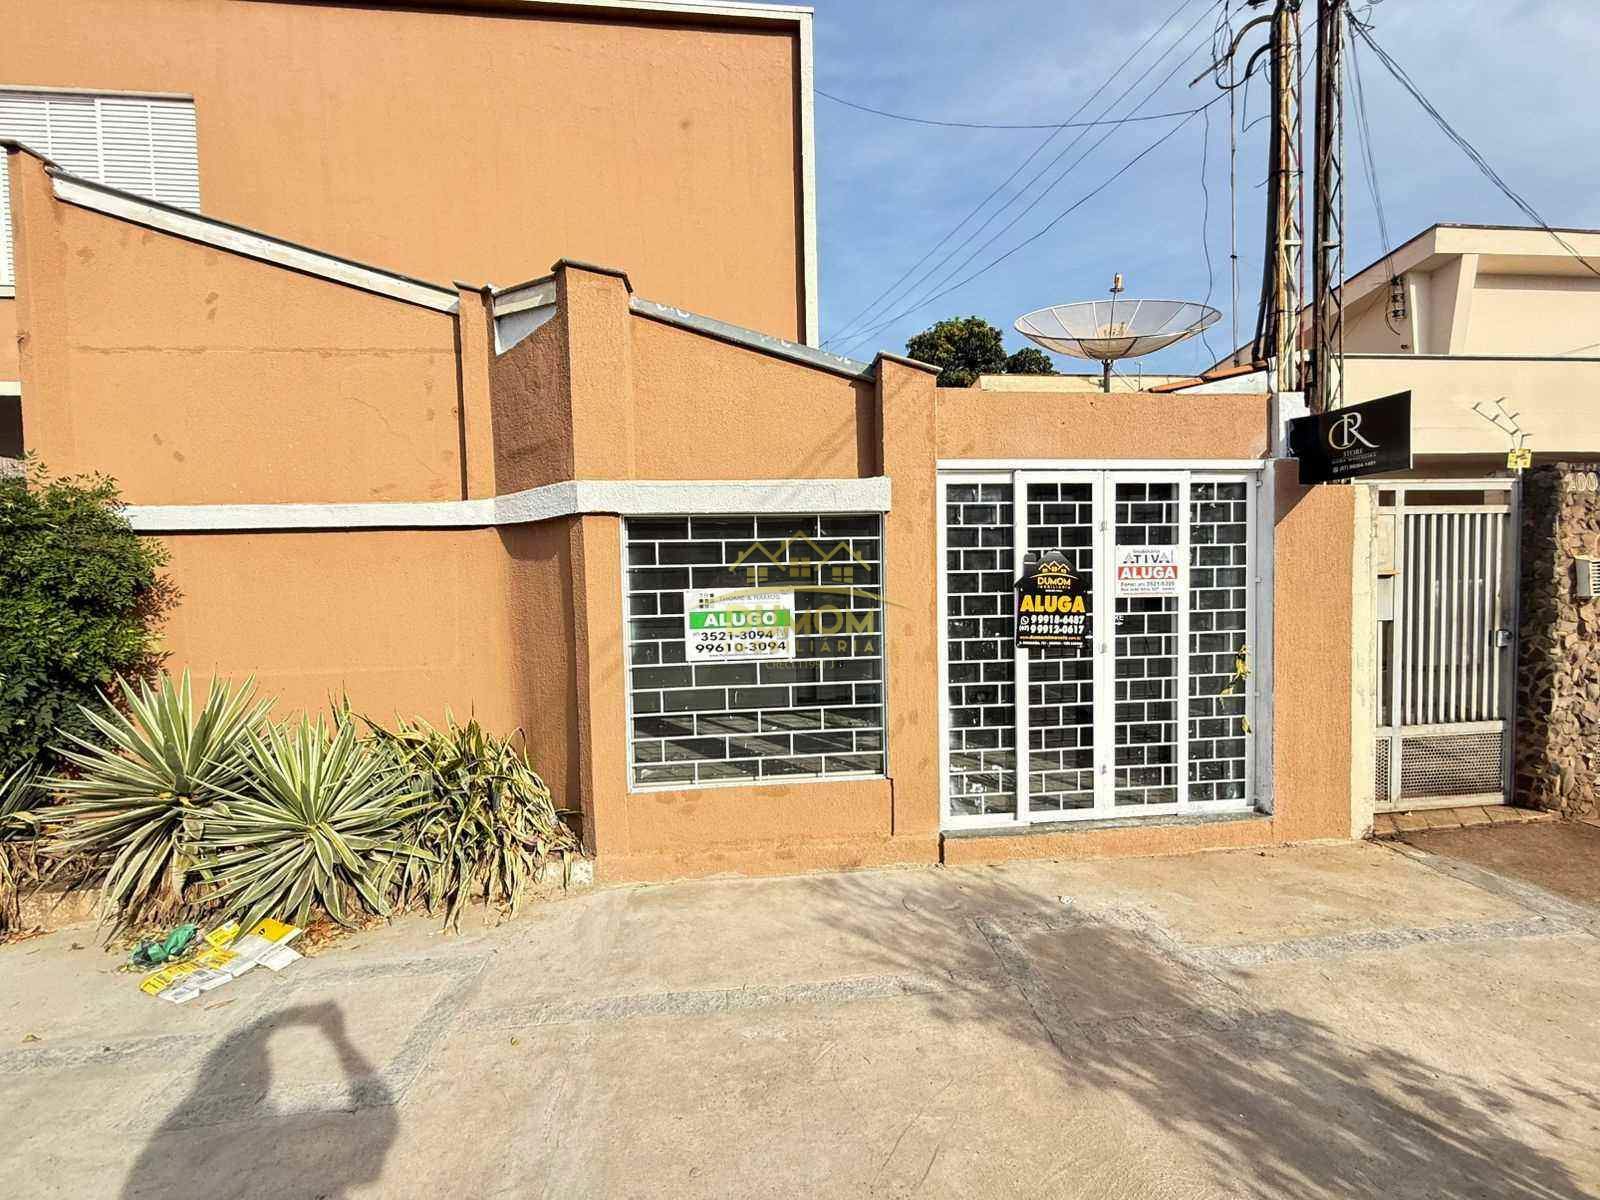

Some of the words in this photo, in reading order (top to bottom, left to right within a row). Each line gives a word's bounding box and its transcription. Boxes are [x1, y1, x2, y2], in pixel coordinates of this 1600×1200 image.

[1123, 553, 1171, 564] ATIVA
[1120, 566, 1176, 579] ALUGA
[1037, 576, 1071, 586] DUMOM
[1020, 594, 1086, 613] ALUGA
[703, 611, 776, 628] ALUGO
[701, 630, 773, 641] 3521-3094
[695, 641, 786, 653] 99610-3094
